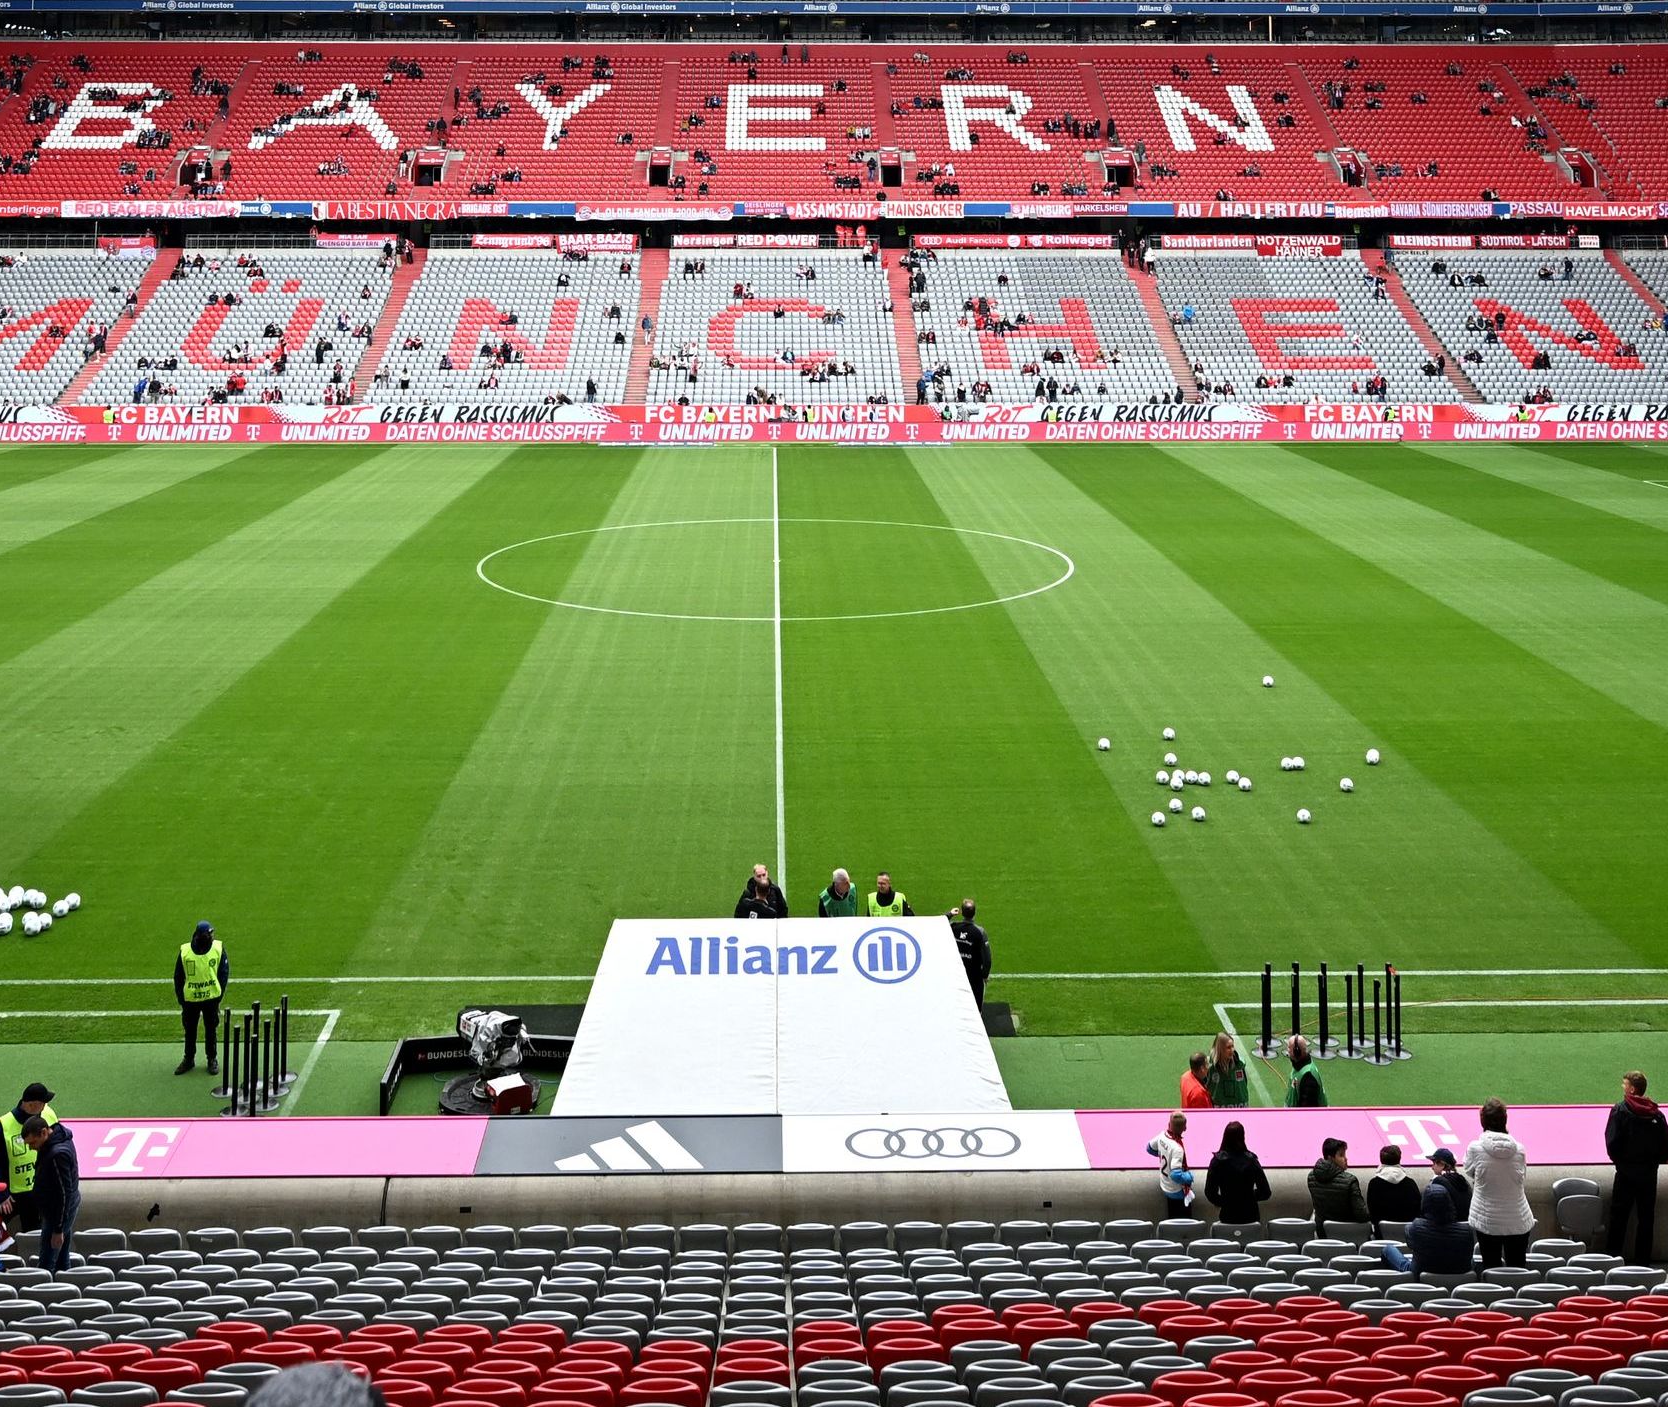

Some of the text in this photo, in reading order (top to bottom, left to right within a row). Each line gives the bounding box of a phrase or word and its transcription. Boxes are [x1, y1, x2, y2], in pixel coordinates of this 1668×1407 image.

[41, 82, 1274, 151] BAYERN
[74, 202, 229, 217] RED EAGLES AUSTRIA
[349, 202, 459, 220] BESTIA NEGRA
[794, 203, 873, 219] ASSAMSTADT
[886, 203, 963, 217] HAINSACKER
[1021, 204, 1071, 217] MAINBURG
[1073, 203, 1128, 213] MARKELSHEIM
[1178, 203, 1202, 217] AU
[1220, 203, 1322, 217] HALLERTAU
[1390, 203, 1492, 217] BAVARIA SÜDNIEDERSACHSEN
[1509, 203, 1563, 215] PASSAU
[1565, 205, 1654, 217] HAVELMACHT
[558, 233, 633, 245] BAAR-BAZIS
[737, 234, 764, 246] RED
[945, 236, 1004, 245] Audi Fanclub
[1164, 235, 1252, 247] Sandharlanden
[1255, 235, 1341, 246] HOTZENWALD
[1393, 235, 1472, 246] KLEINOSTHEIM
[1275, 244, 1323, 257] HÄNNER
[144, 406, 239, 423] BAYERN
[380, 404, 562, 424] GEGEN RASSISMUS
[645, 405, 780, 423] FC BAYERN
[1113, 404, 1221, 423] RASSISMUS
[1304, 405, 1434, 422] FC BAYERN
[1566, 403, 1633, 423] GEGEN
[136, 424, 232, 441] UNLIMITED
[281, 423, 607, 441] UNLIMITED DATEN OHNE SCHLUSSPFIFF
[659, 423, 754, 440] UNLIMITED
[795, 423, 890, 440] UNLIMITED
[942, 423, 1263, 440] UNLIMITED DATEN OHNE SCHLUSSPFIFF
[1310, 423, 1404, 440] UNLIMITED
[1453, 423, 1541, 439] UNLIMITED
[1555, 423, 1609, 439] DATEN
[1610, 423, 1657, 439] OHNE
[645, 935, 838, 976] Allianz
